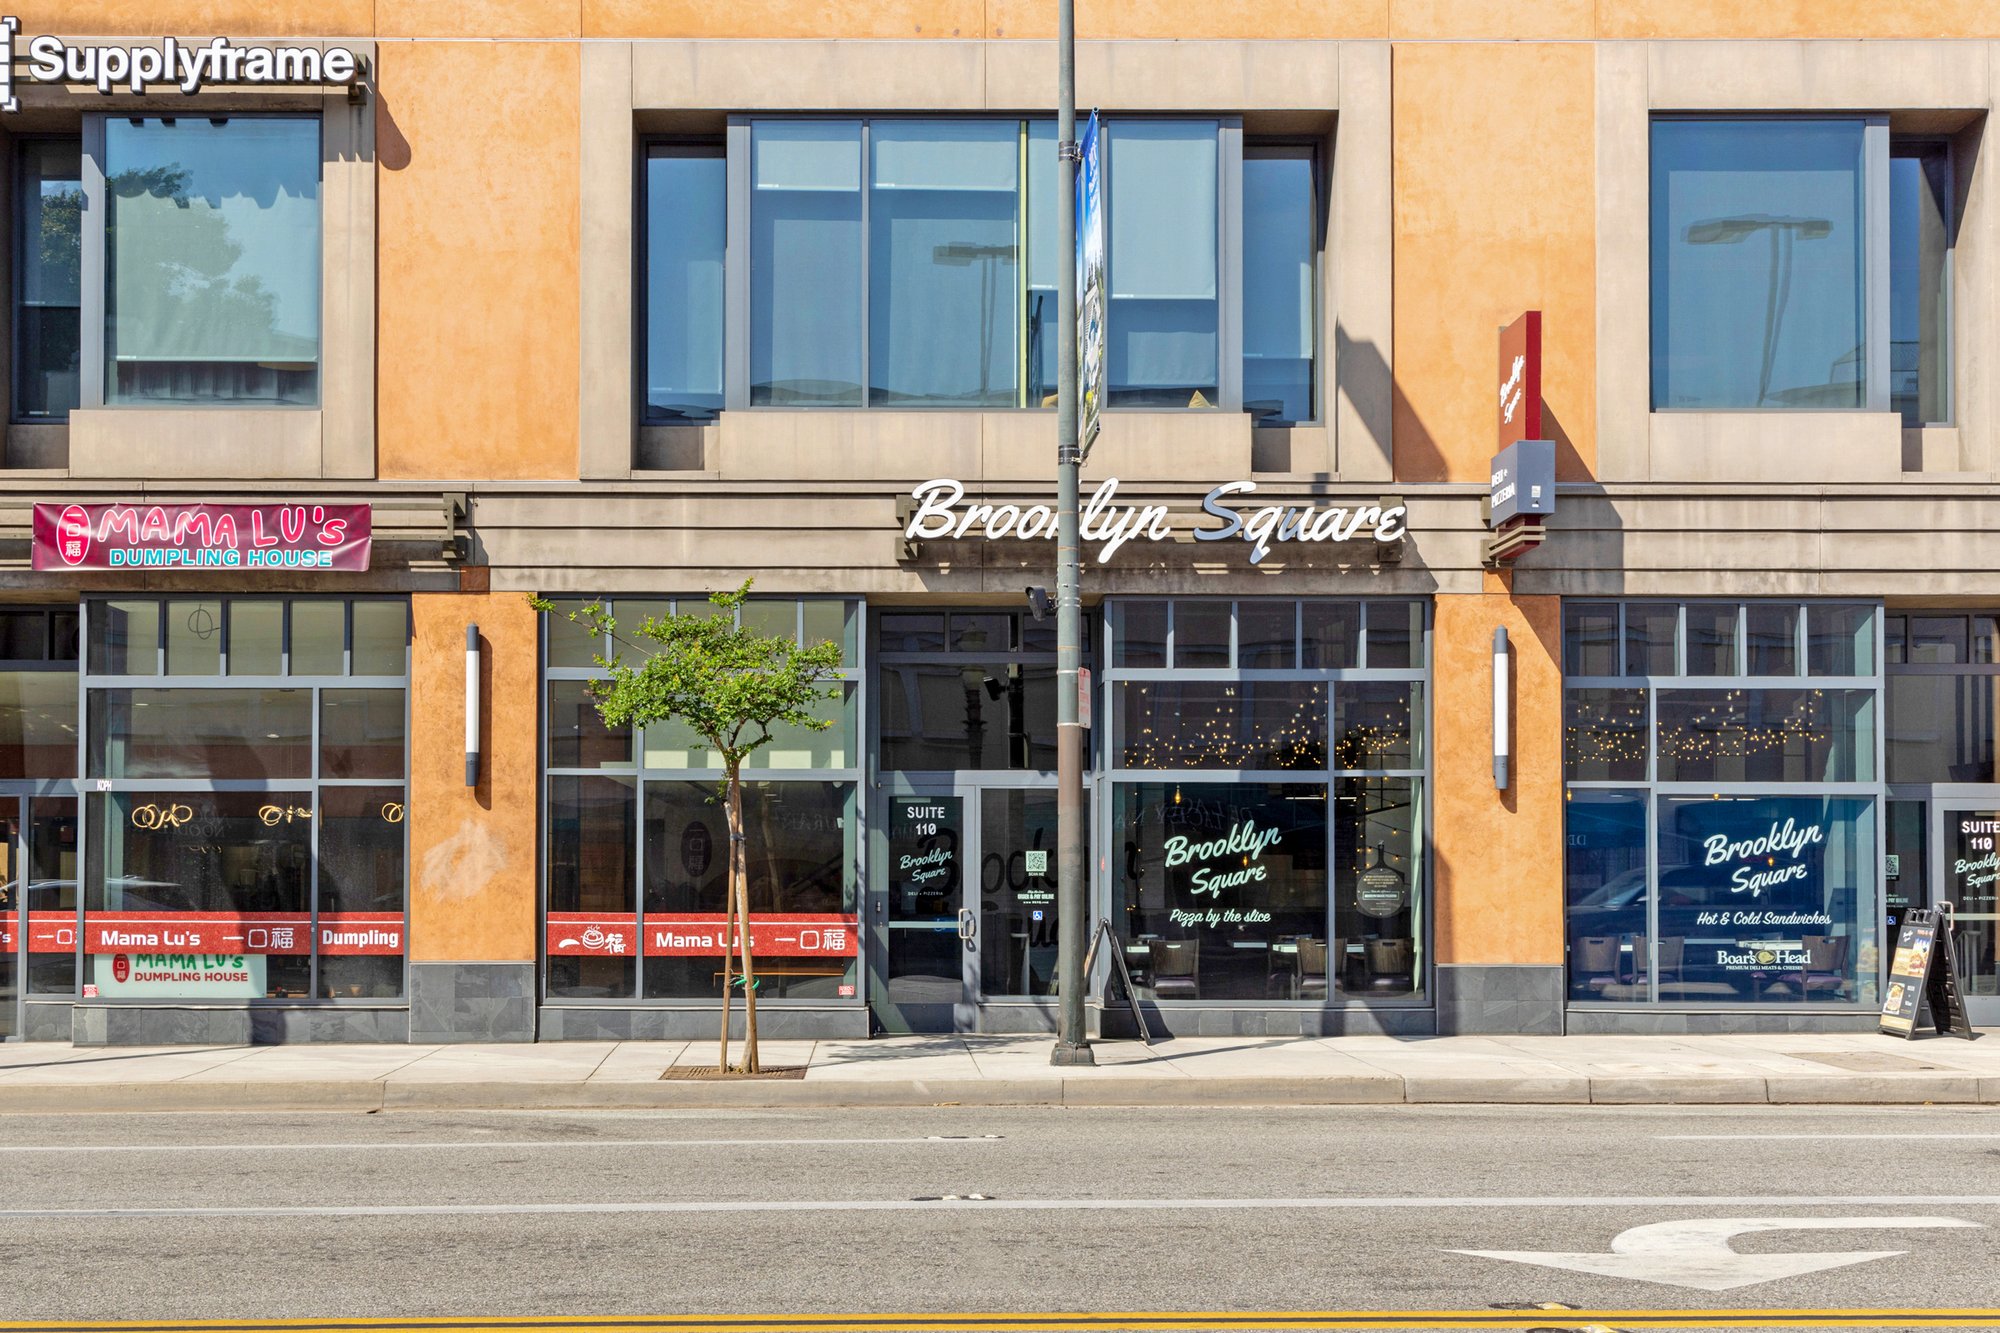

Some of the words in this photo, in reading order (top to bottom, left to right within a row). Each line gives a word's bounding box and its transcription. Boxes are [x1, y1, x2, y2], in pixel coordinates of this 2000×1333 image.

[29, 35, 356, 93] Supplyframe
[98, 507, 238, 548] MAMA
[905, 476, 1171, 564] Broolyn
[1194, 480, 1408, 564] Square
[109, 549, 240, 567] DUMPLING
[247, 549, 333, 567] HOUSE
[907, 806, 946, 819] SUITE
[915, 823, 937, 836] 110
[1961, 821, 2000, 834] SUITE
[1164, 819, 1282, 868] Brooklyn
[1703, 817, 1823, 867] Brooklyn
[1970, 837, 1993, 850] 110
[900, 847, 953, 870] Brooklyn
[1954, 851, 2000, 874] Brookly
[911, 867, 947, 883] Square
[1190, 865, 1267, 899] Square
[1730, 864, 1808, 898] Square
[1169, 908, 1203, 927] Pizza
[1205, 908, 1221, 929] by
[1223, 908, 1242, 923] the
[1243, 909, 1271, 923] slice
[1697, 912, 1718, 926] Hot
[1720, 912, 1730, 926] &
[1733, 911, 1762, 926] Cold
[1762, 911, 1832, 925] Sandwiches
[36, 929, 77, 945] 一口
[101, 930, 158, 946] Mama
[163, 930, 200, 946] Lu's
[222, 927, 295, 949] 一口福
[322, 929, 399, 948] Dumpling
[656, 932, 713, 948] Mama
[774, 929, 846, 950] 一口福
[136, 953, 197, 970] MAMA
[1716, 950, 1756, 965] Boar's
[1775, 949, 1812, 965] Head
[134, 972, 201, 982] DUMPLING
[204, 972, 248, 982] HOUSE
